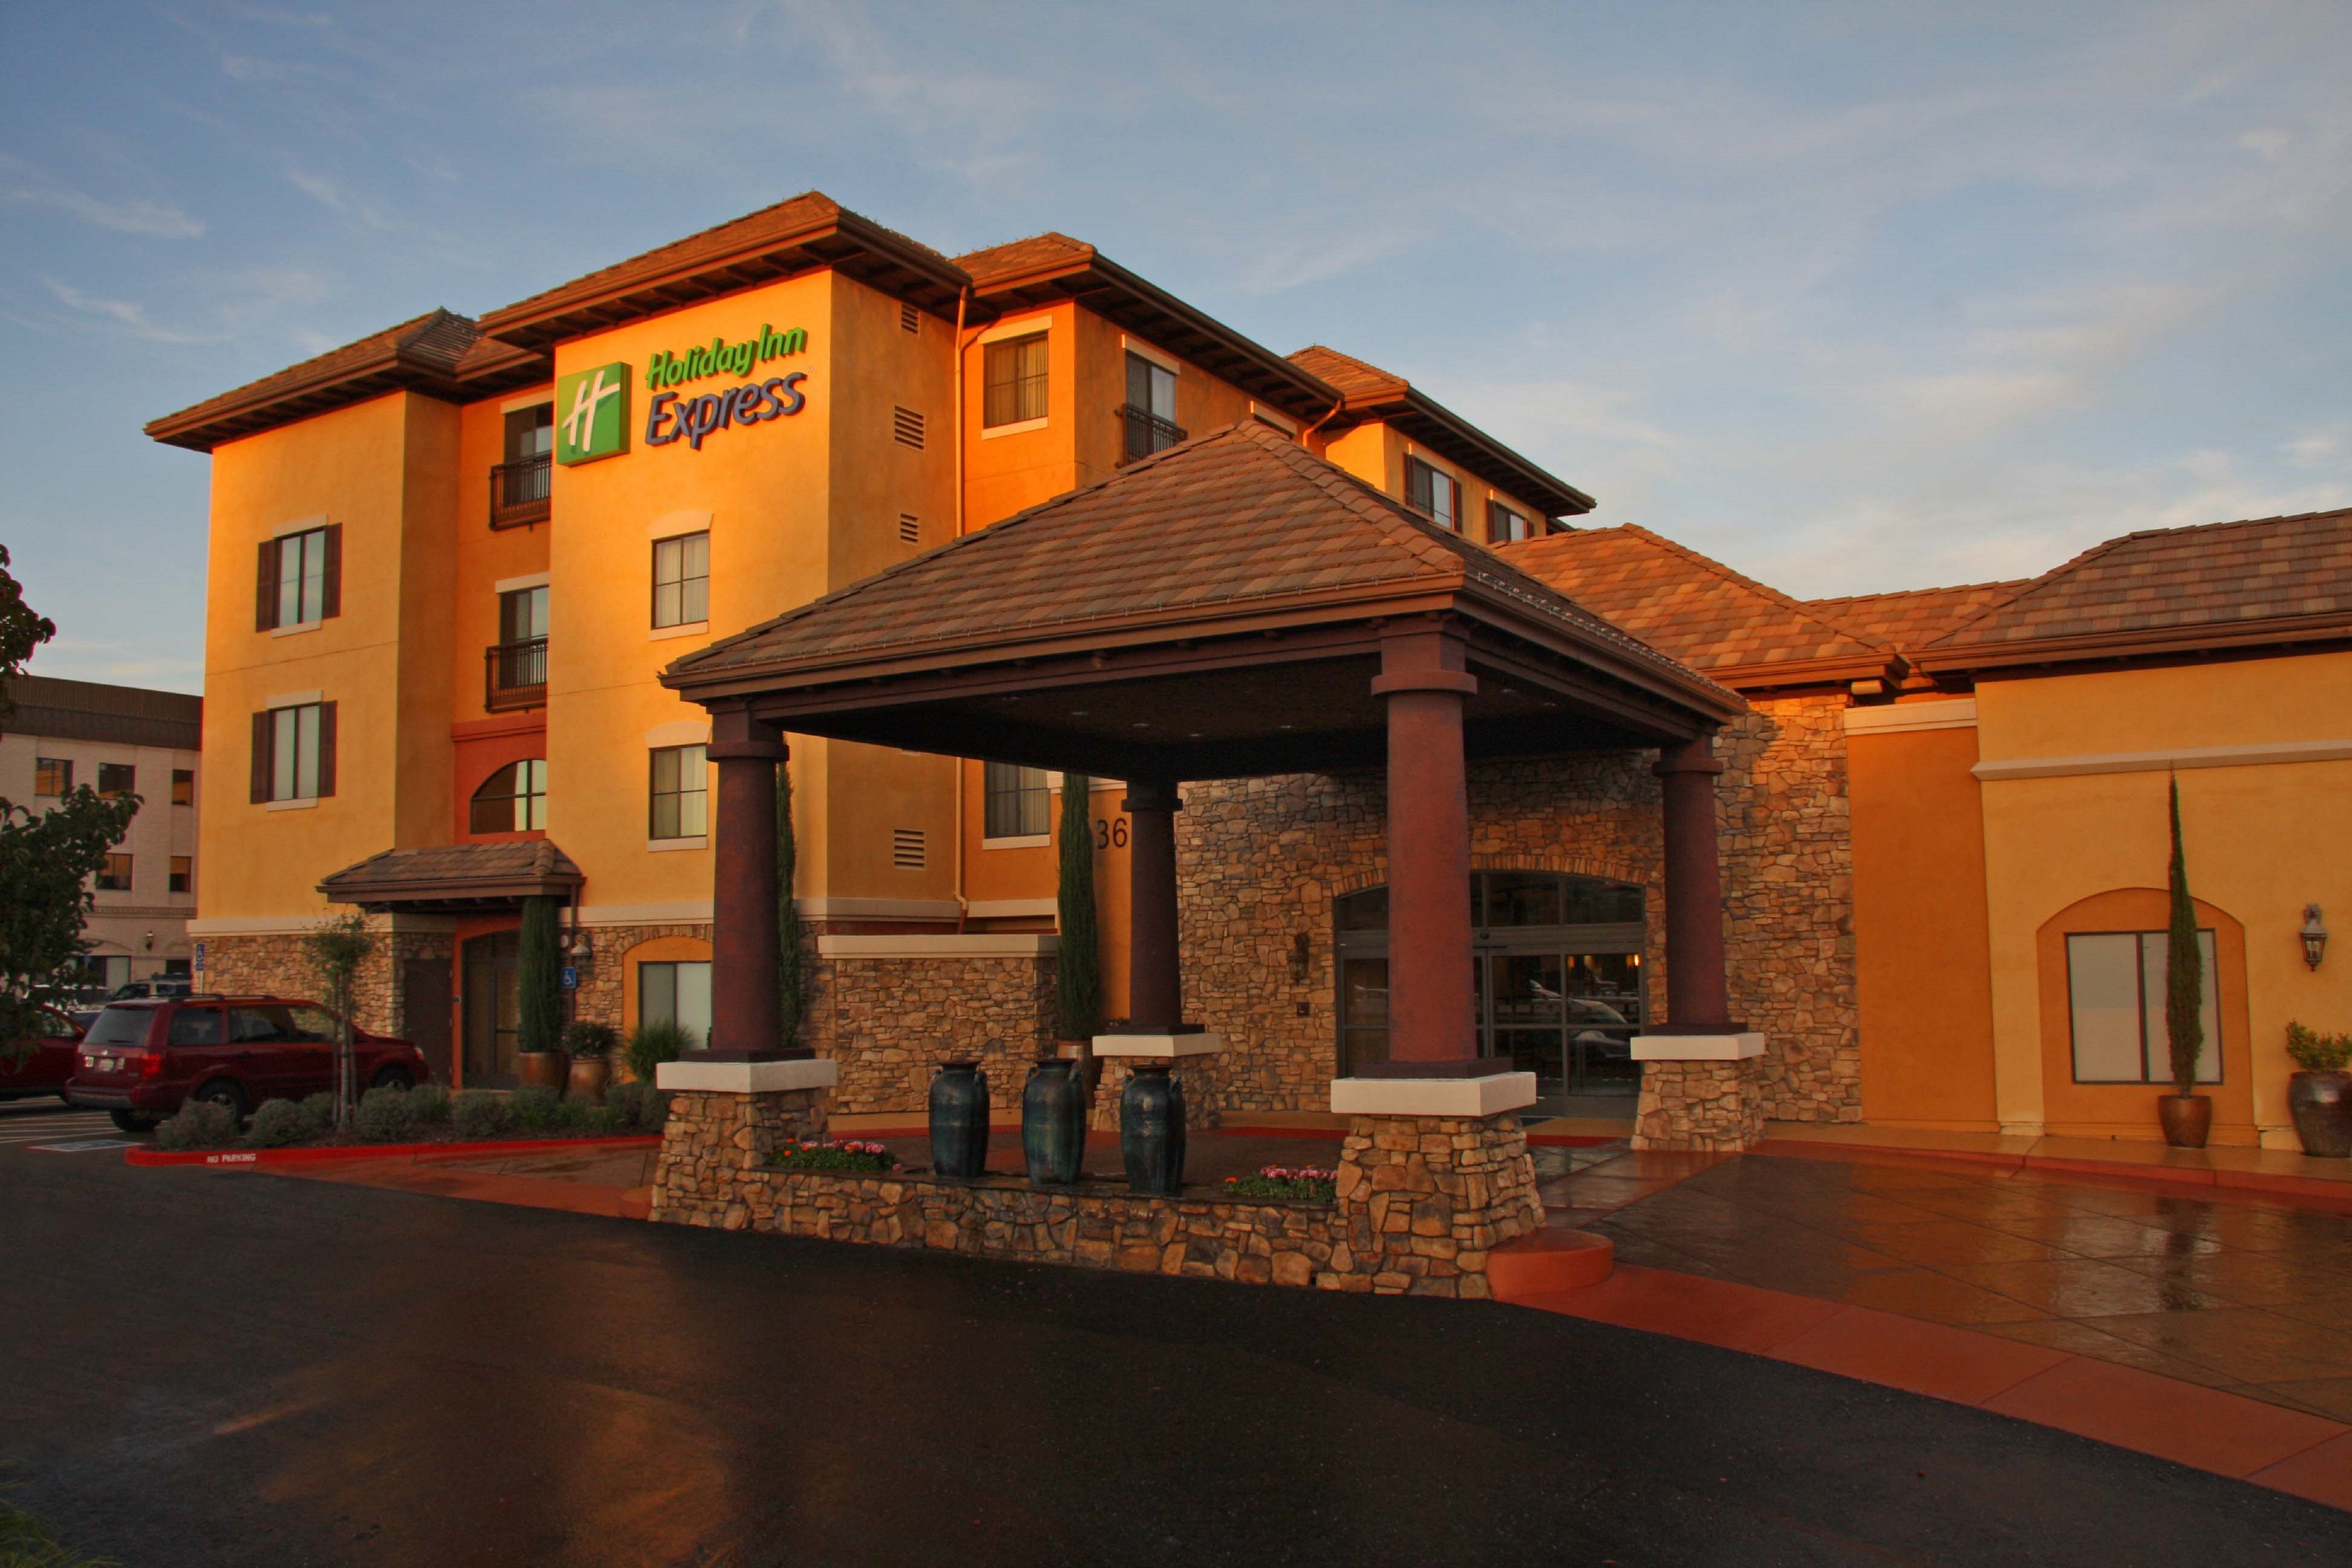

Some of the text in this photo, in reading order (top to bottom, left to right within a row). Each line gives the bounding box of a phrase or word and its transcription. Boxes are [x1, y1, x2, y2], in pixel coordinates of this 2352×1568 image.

[646, 323, 808, 390] Holiday Inn
[645, 371, 807, 450] Express
[222, 1153, 256, 1162] PARKING
